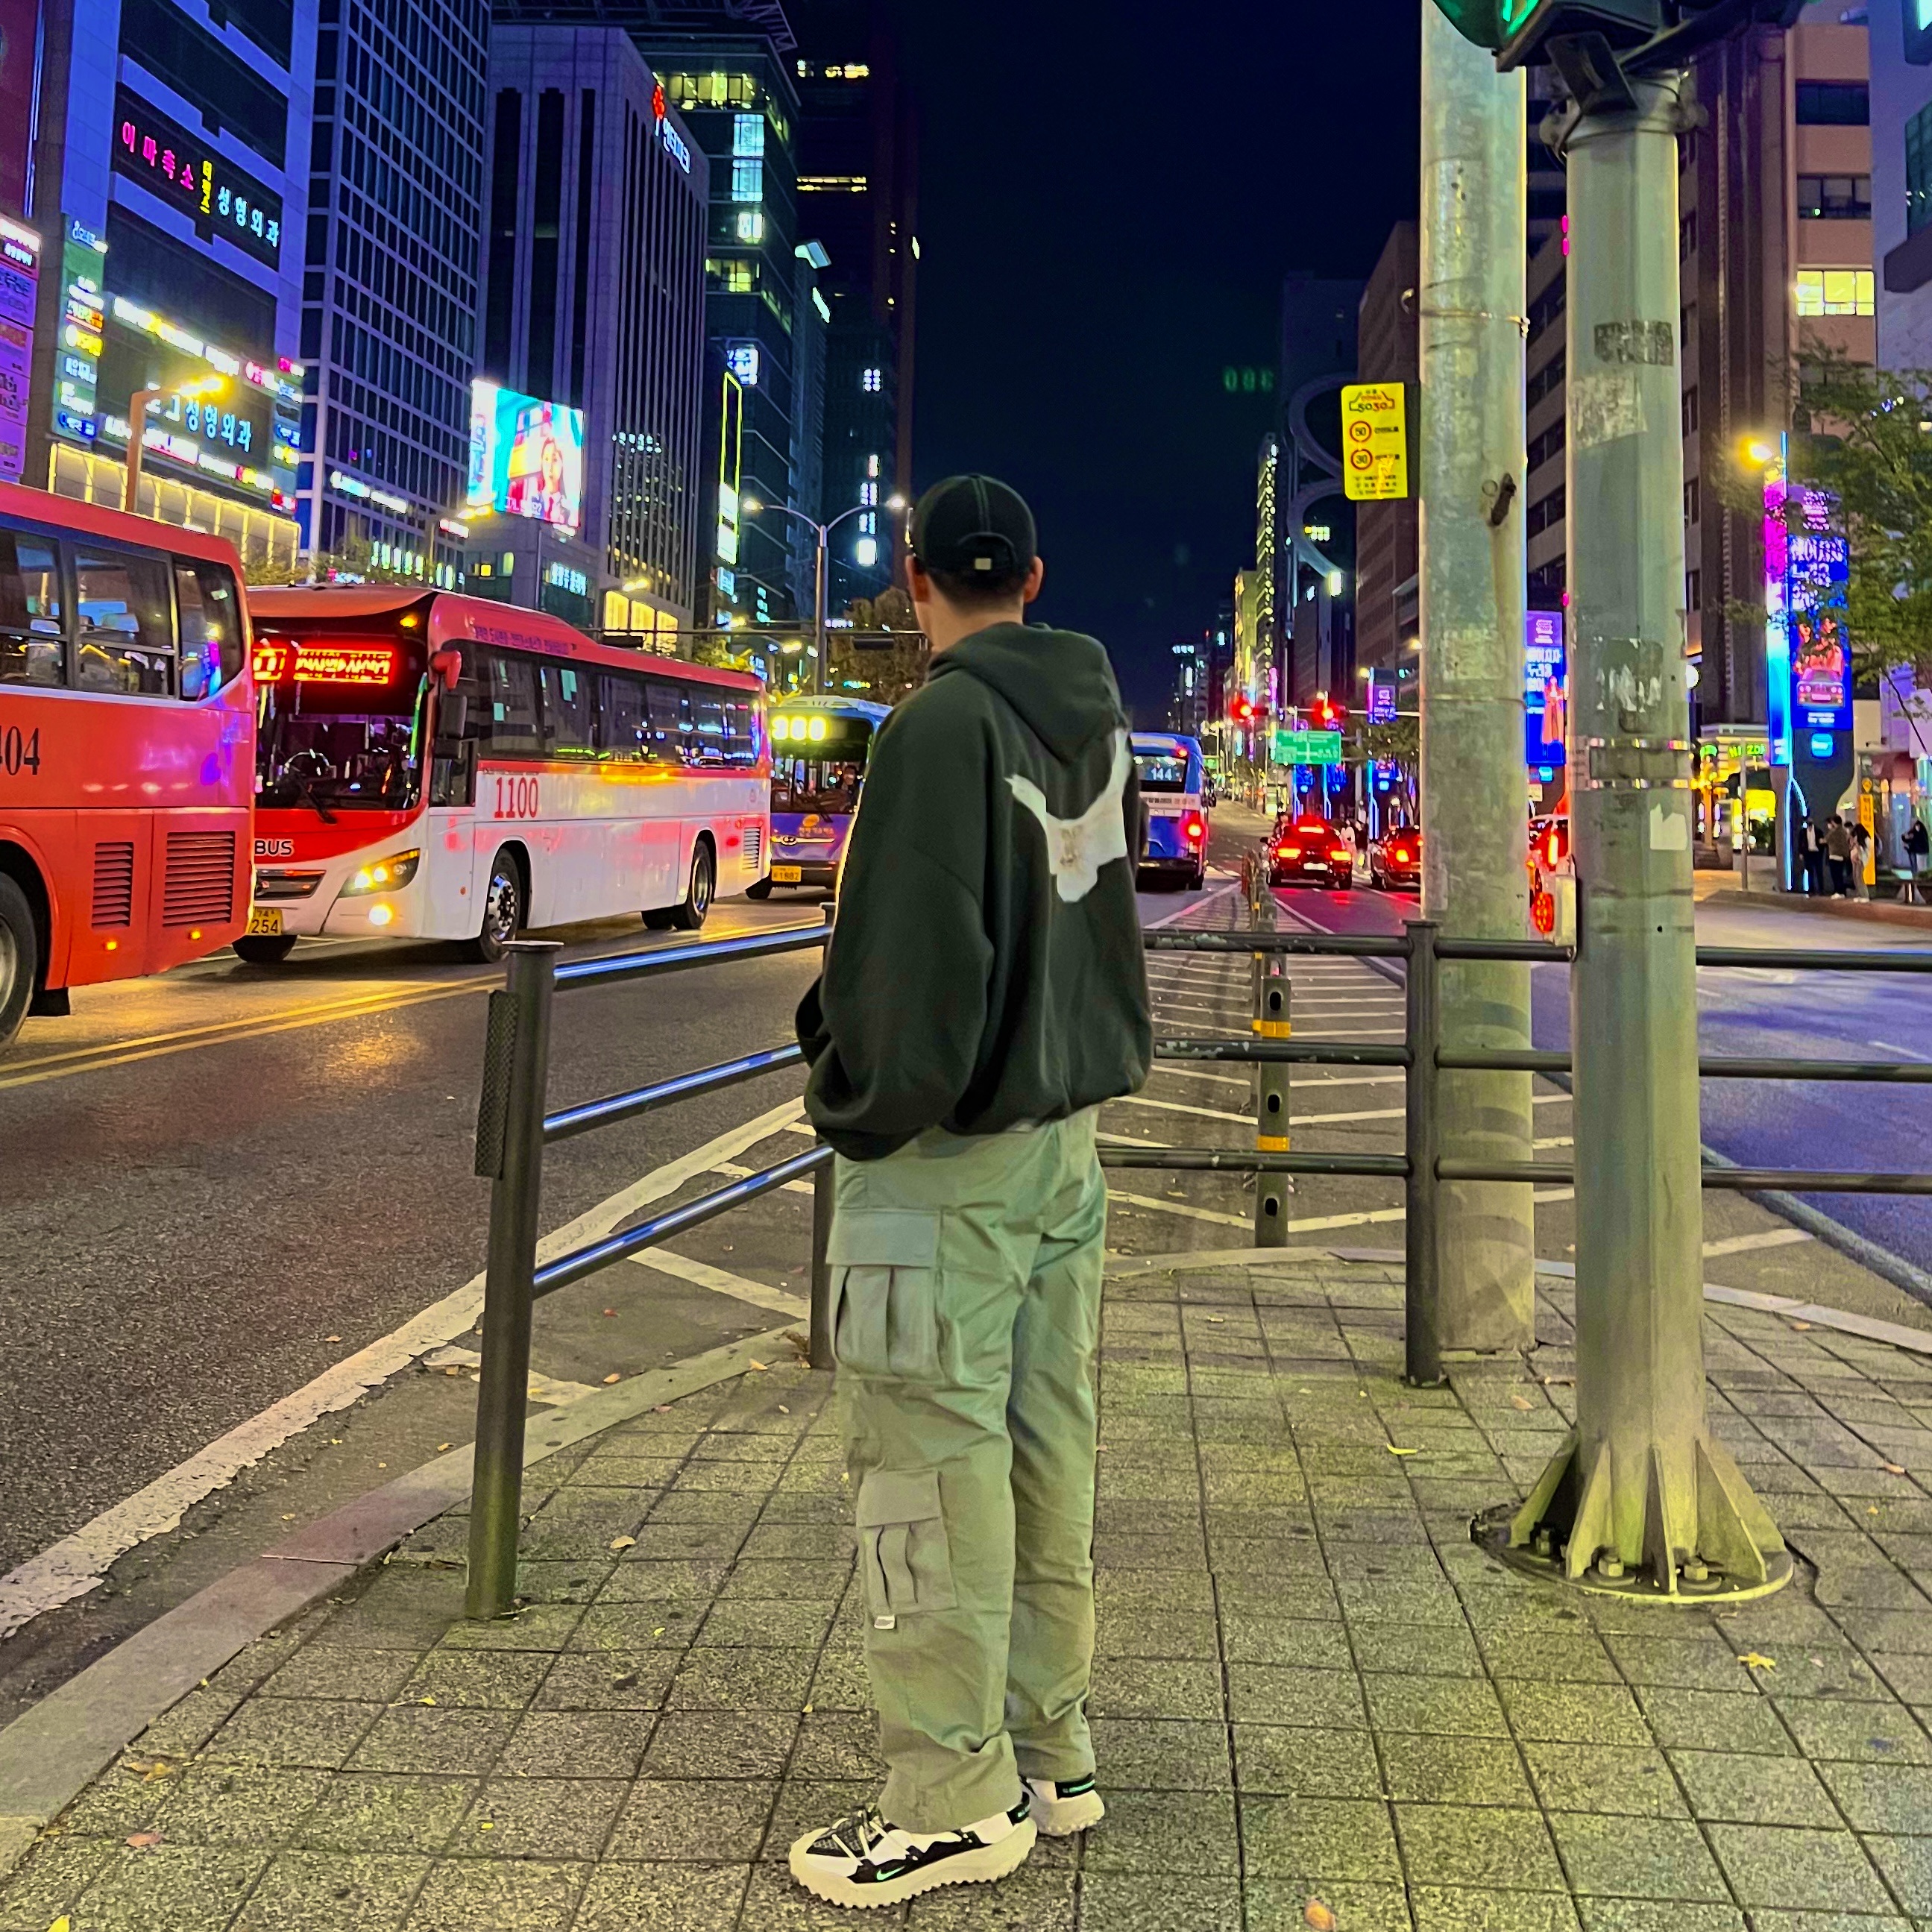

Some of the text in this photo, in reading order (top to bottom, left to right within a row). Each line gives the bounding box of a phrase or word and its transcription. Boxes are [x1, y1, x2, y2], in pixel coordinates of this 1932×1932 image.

[218, 186, 280, 248] 성형외과
[0, 726, 40, 775] 04
[1151, 767, 1173, 781] 144
[494, 777, 538, 819] 1100
[254, 839, 294, 856] BUS
[251, 919, 279, 934] 254
